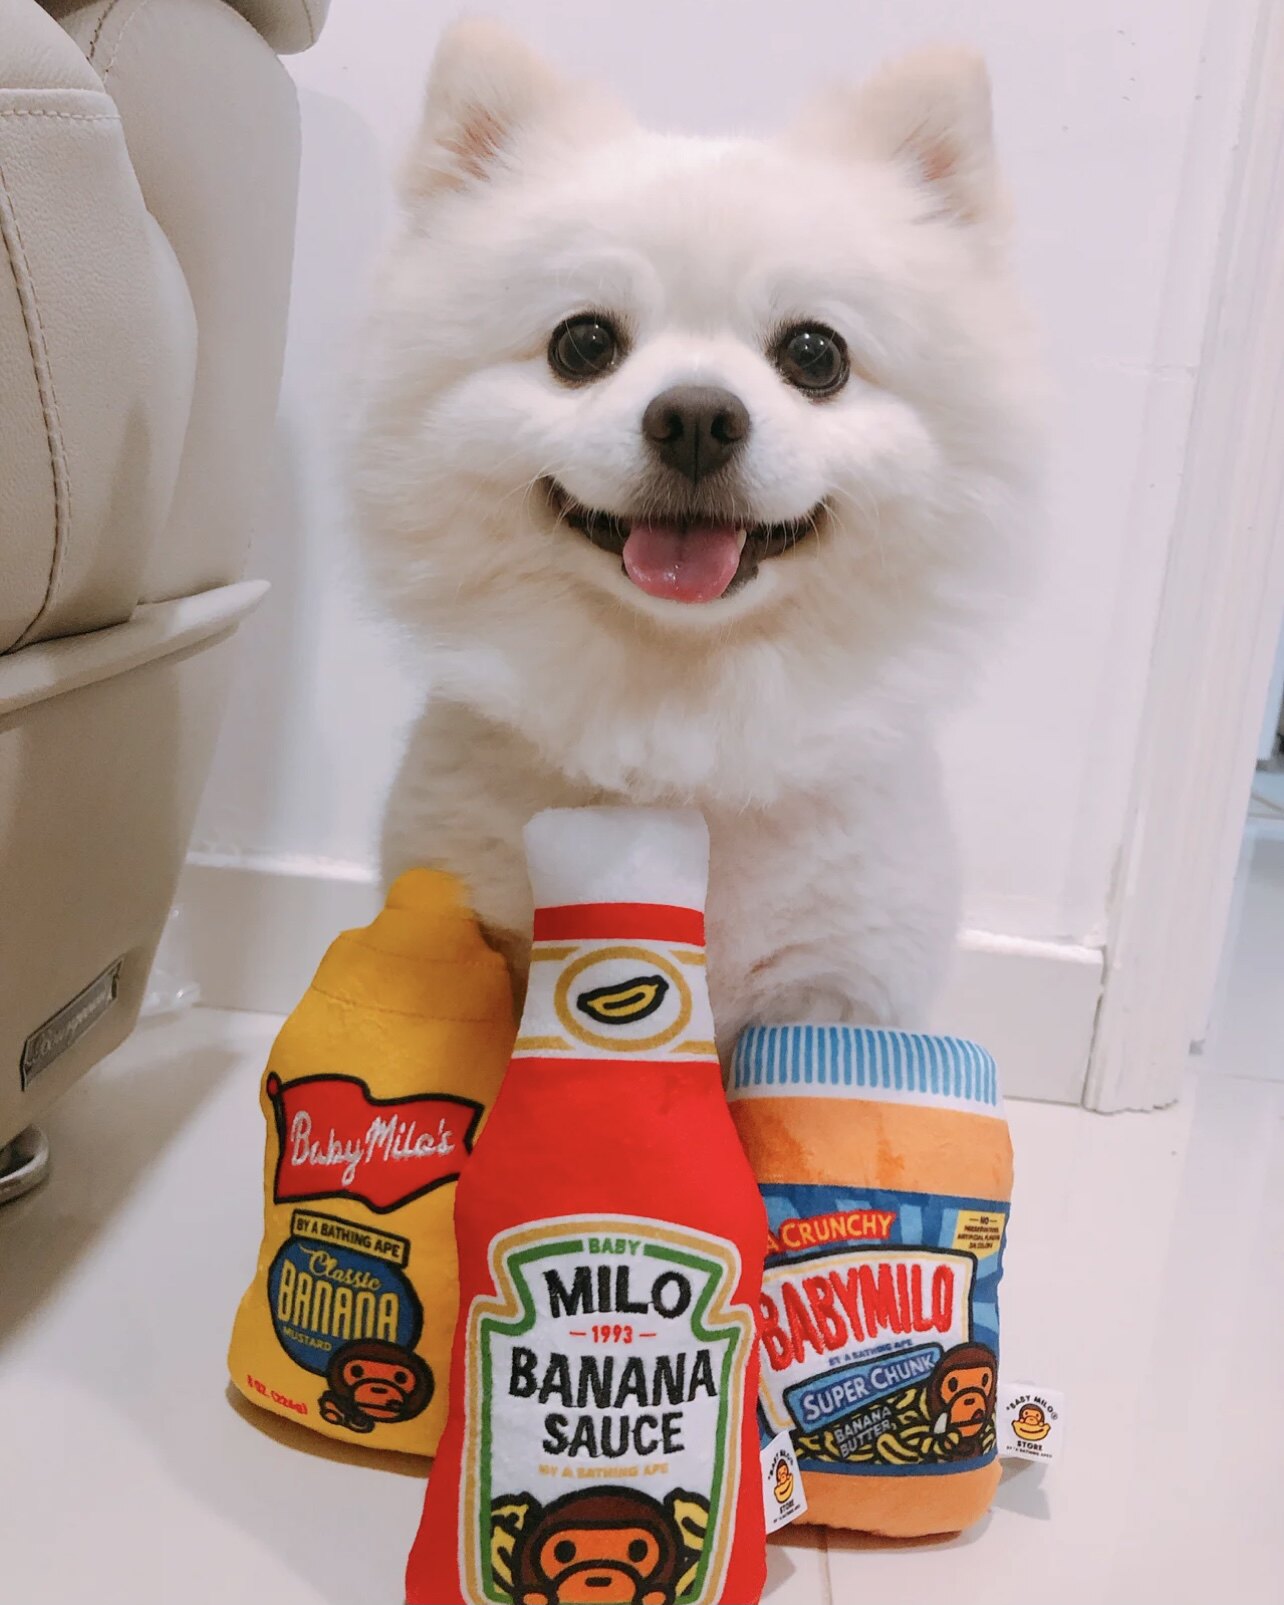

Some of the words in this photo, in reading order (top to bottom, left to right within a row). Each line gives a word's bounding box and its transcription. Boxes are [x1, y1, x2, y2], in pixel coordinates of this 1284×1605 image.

[291, 1110, 363, 1186] Baby
[365, 1114, 455, 1161] Milo's
[296, 1218, 311, 1232] BY
[311, 1221, 318, 1234] A
[320, 1223, 372, 1249] BATHING
[374, 1240, 400, 1258] APE
[588, 1237, 642, 1256] BABY
[781, 1214, 892, 1248] CRUNCHY
[299, 1244, 382, 1291] Classic
[277, 1258, 399, 1344] BANANA
[542, 1264, 692, 1319] MILO
[283, 1326, 333, 1352] MUSTARD
[591, 1324, 633, 1344] 1993
[508, 1346, 719, 1409] BANANA
[803, 1376, 870, 1421] SUPER
[870, 1354, 936, 1389] CHUNK
[542, 1412, 685, 1459] SAUCE
[834, 1406, 892, 1444] BANANA
[840, 1419, 892, 1458] BUTTER
